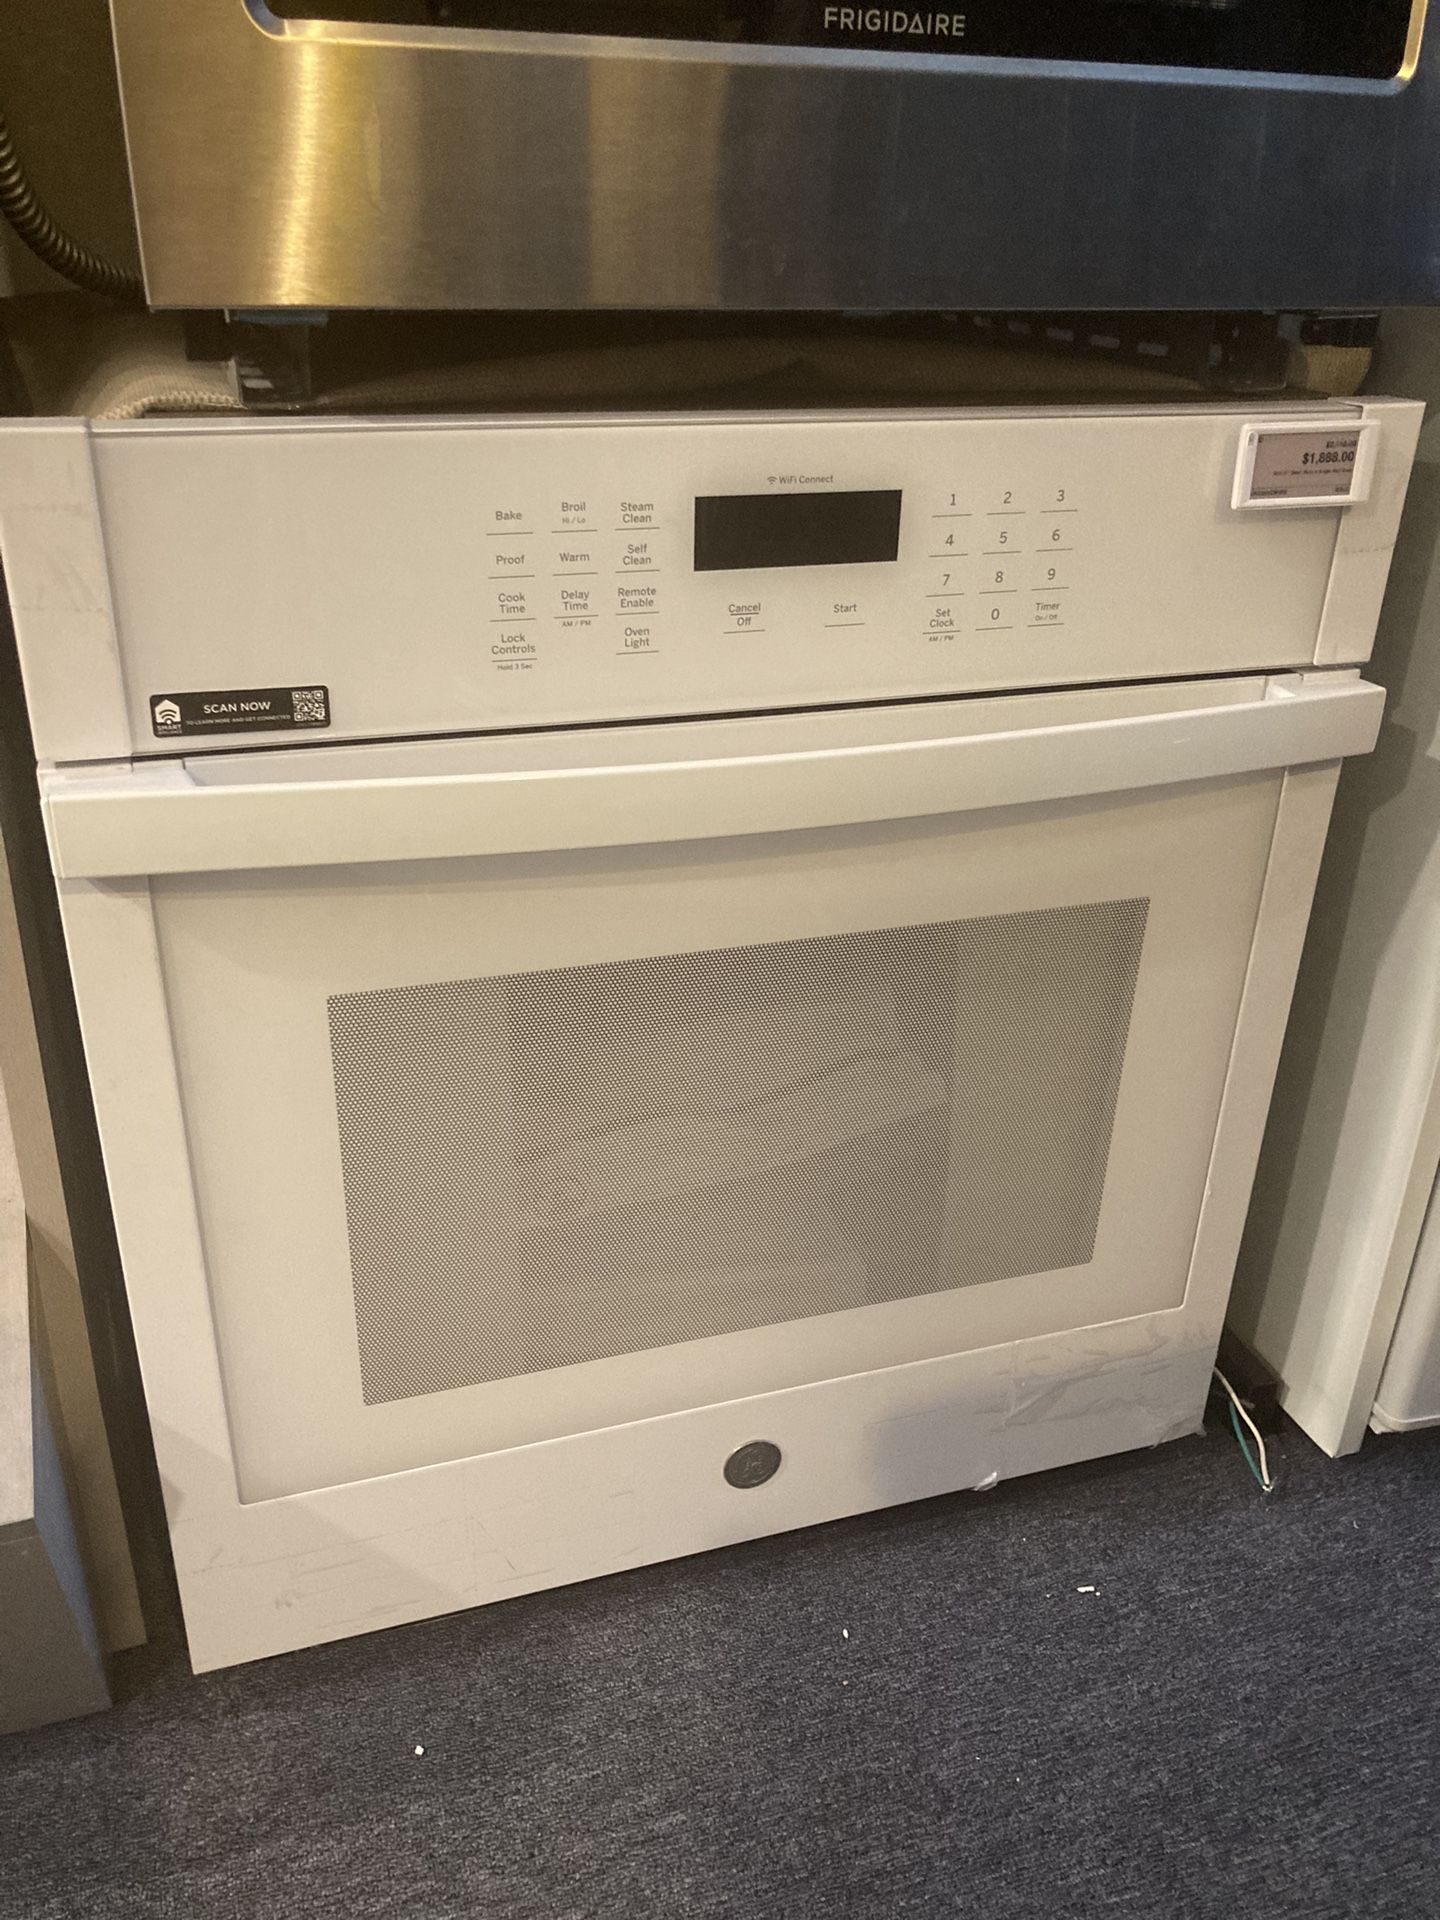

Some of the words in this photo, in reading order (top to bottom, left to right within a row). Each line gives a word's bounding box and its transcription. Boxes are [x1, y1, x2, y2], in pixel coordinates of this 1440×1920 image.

[823, 7, 966, 37] FRIGIDAIRE
[1302, 451, 1354, 465] $1,888.00
[779, 476, 797, 484] WiFi
[799, 475, 833, 484] Connect
[950, 493, 956, 506] 1
[1003, 491, 1012, 504] 2
[1056, 489, 1065, 502] 3
[561, 502, 586, 512] Broil
[620, 502, 654, 512] Steam
[495, 511, 523, 521] Bake
[622, 513, 652, 524] Clean
[945, 534, 954, 546] 4
[999, 531, 1008, 544] 5
[1052, 529, 1060, 542] 6
[627, 544, 647, 554] Self
[495, 554, 525, 565] Proof
[559, 552, 590, 562] Warm
[622, 555, 652, 566] Clean
[942, 573, 950, 586] 7
[995, 571, 1003, 583] 8
[1047, 568, 1056, 581] 9
[498, 592, 526, 603] Cook
[561, 590, 589, 601] Delay
[618, 587, 657, 597] Remote
[500, 604, 526, 614] Time
[563, 601, 588, 611] Time
[620, 598, 654, 609] Enable
[728, 603, 761, 613] Cancel
[833, 604, 857, 613] Start
[1036, 602, 1060, 611] Timer
[936, 608, 951, 617] Set
[580, 619, 591, 627] PM
[736, 617, 751, 626] Off
[929, 618, 954, 628] Clock
[624, 627, 650, 637] Oven
[501, 633, 525, 643] Lock
[624, 638, 650, 649] Light
[491, 644, 536, 655] Controls
[203, 703, 238, 714] SCAN
[240, 701, 271, 711] NOW
